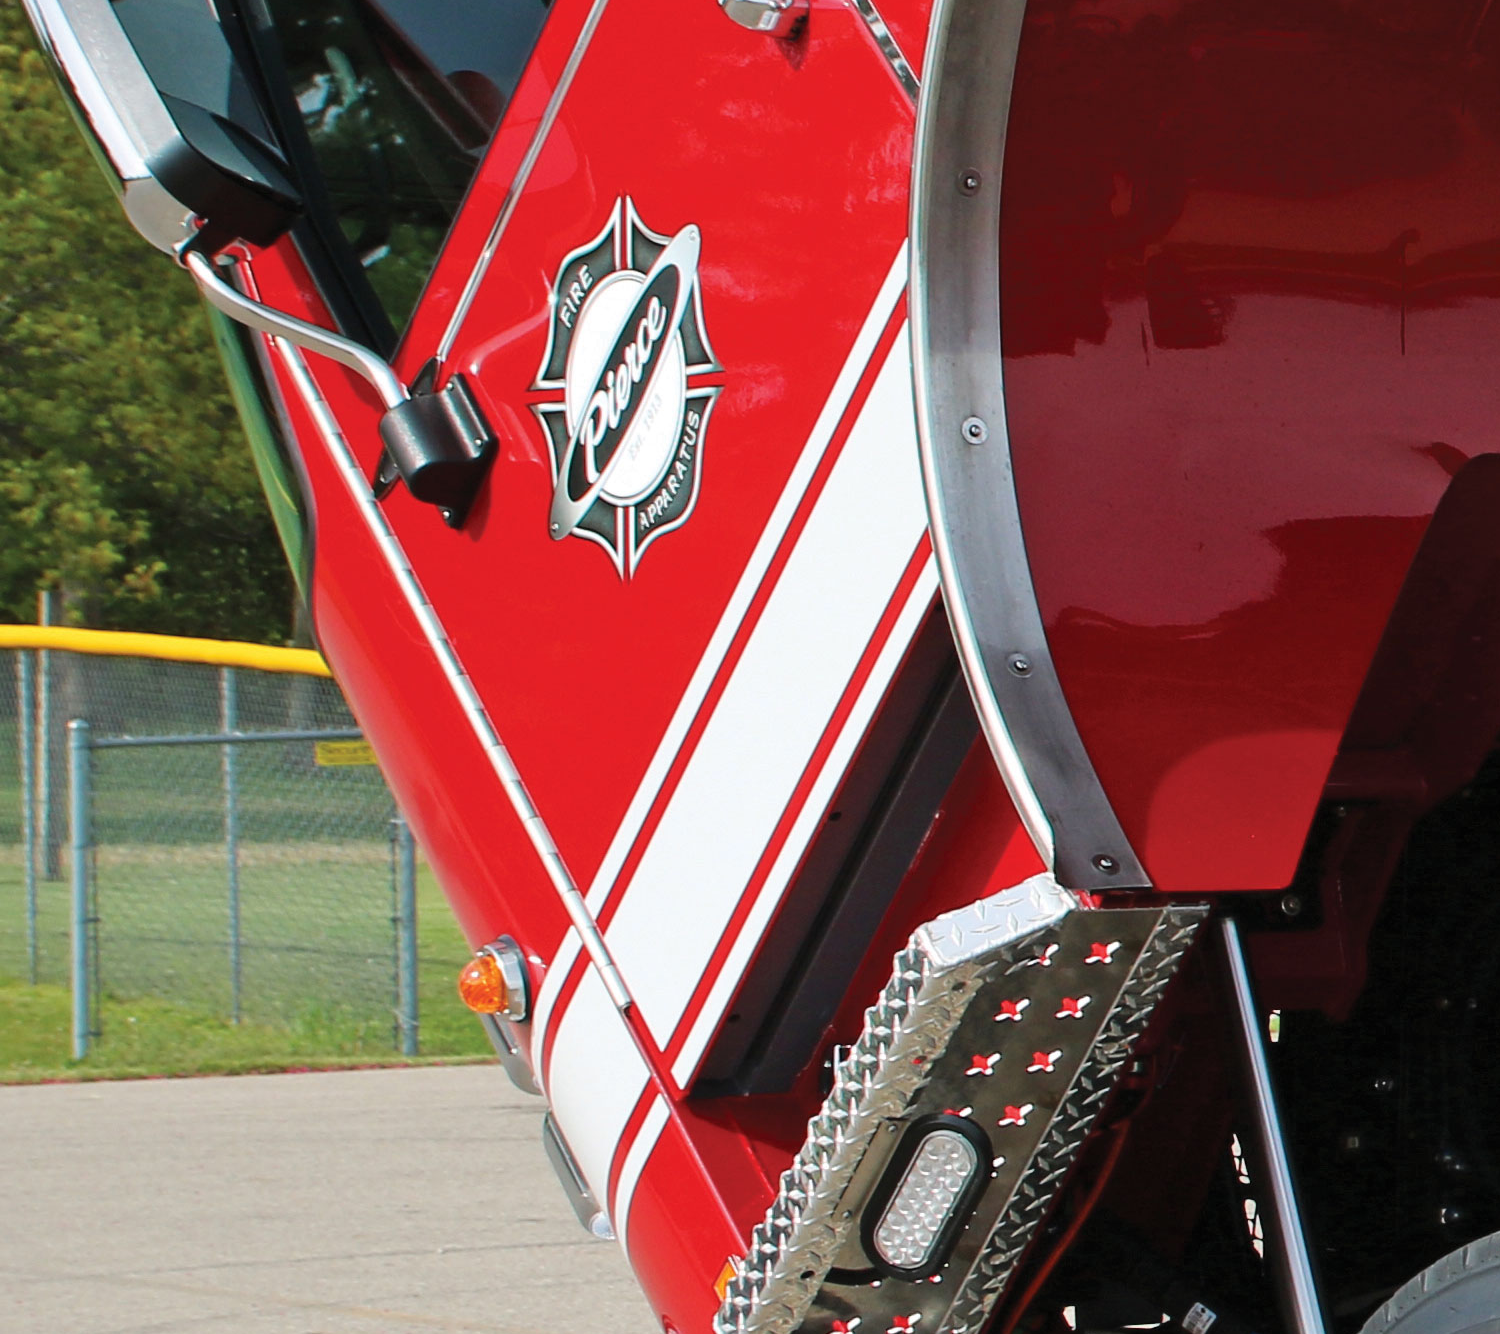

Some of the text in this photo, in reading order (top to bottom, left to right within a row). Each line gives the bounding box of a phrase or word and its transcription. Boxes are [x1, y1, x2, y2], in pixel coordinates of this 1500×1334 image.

[561, 264, 593, 329] FIRE
[580, 295, 668, 484] Pierce
[639, 410, 701, 533] APPARATUS
